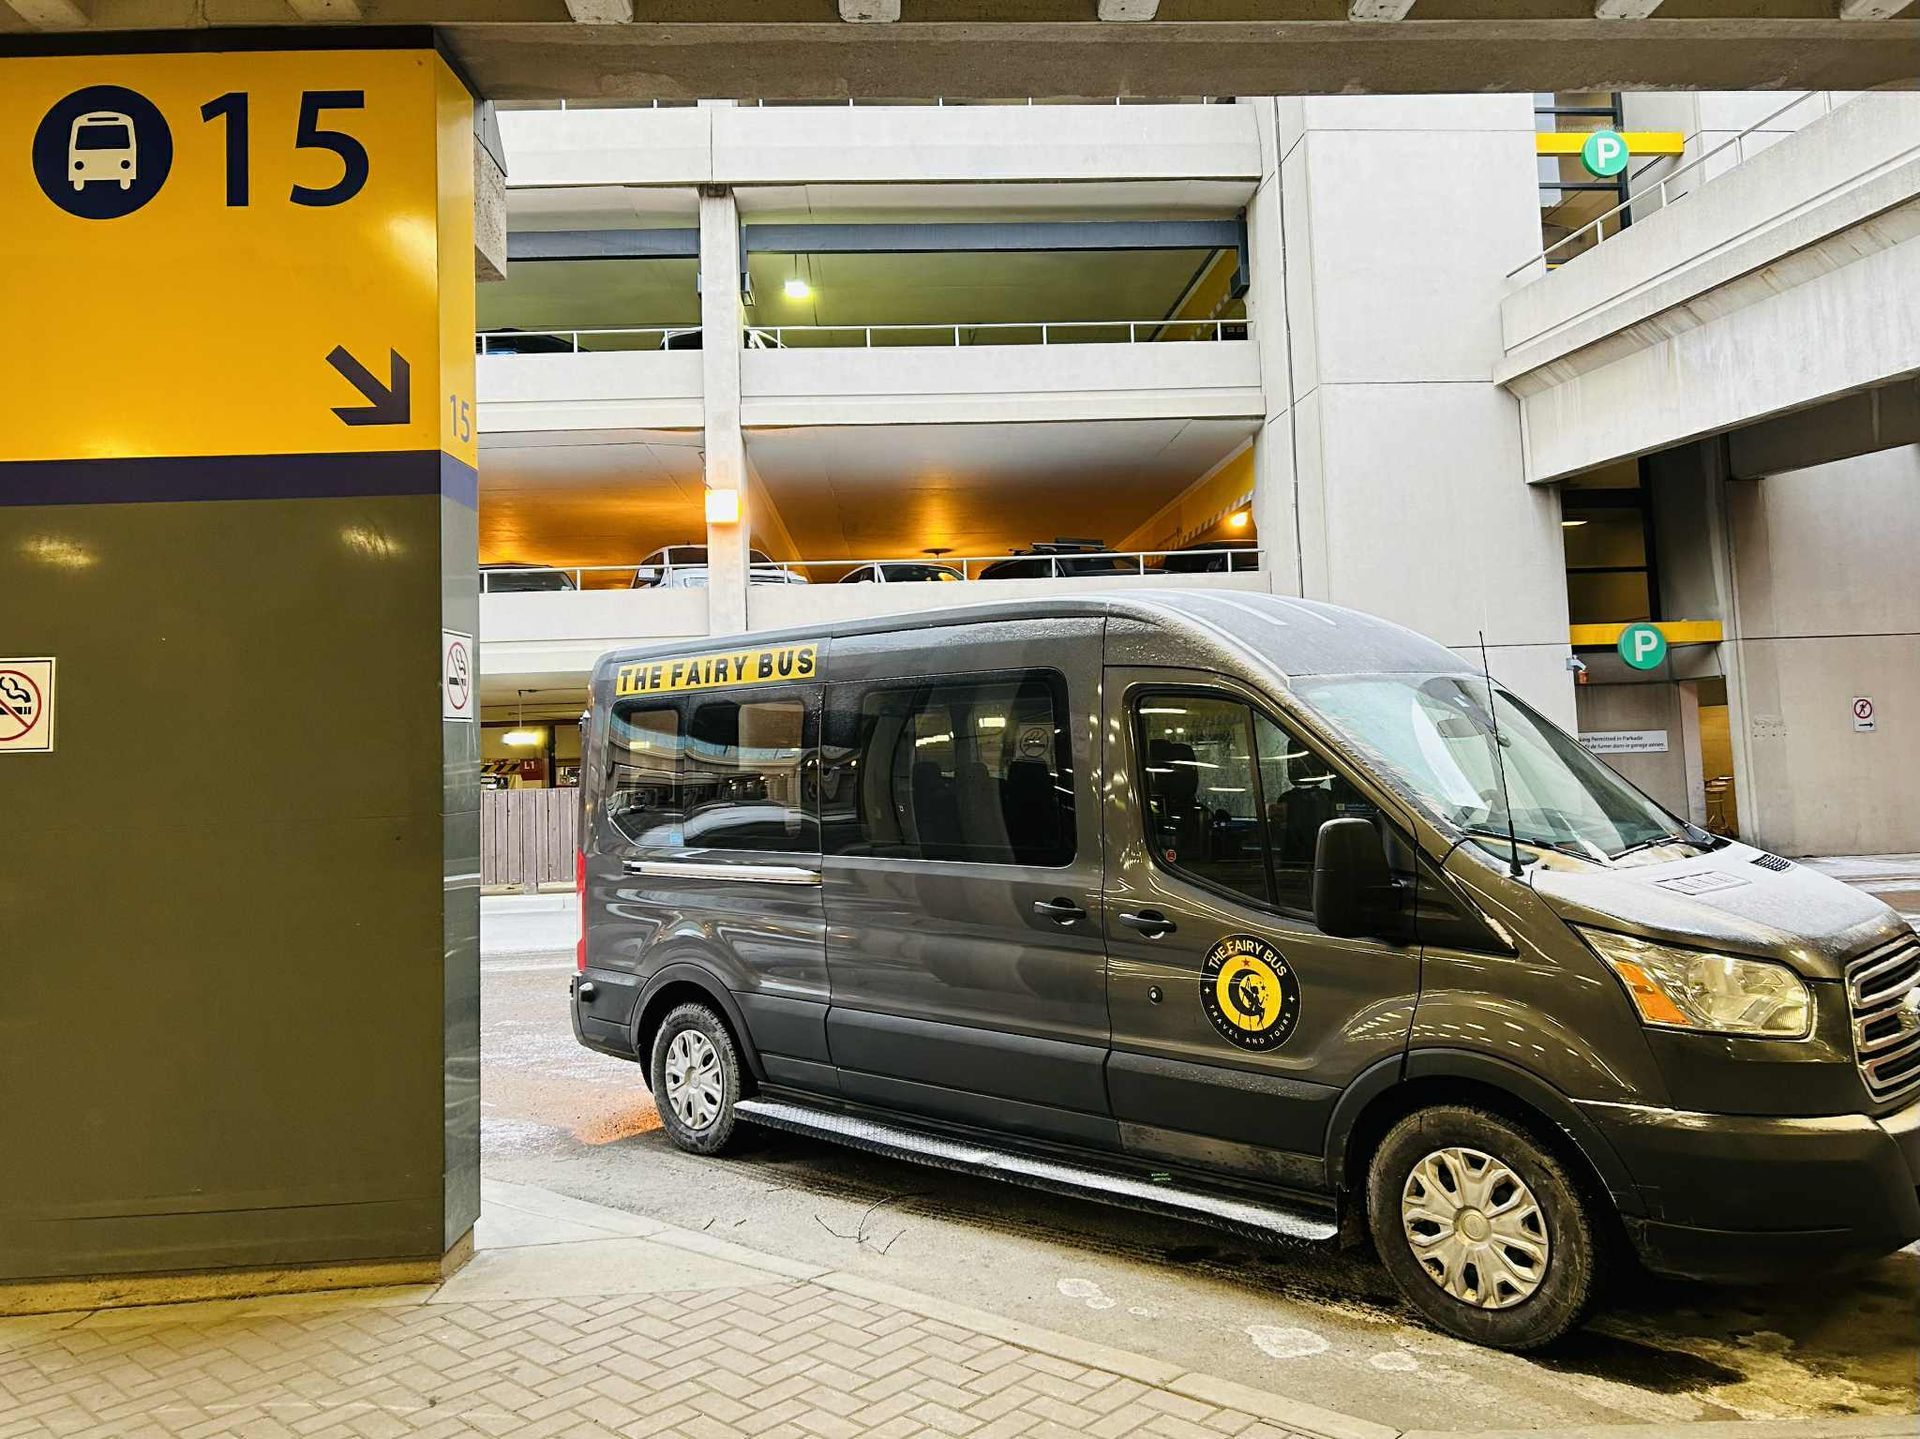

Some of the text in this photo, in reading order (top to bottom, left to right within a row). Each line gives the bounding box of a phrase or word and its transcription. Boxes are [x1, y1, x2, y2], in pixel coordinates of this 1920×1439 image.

[200, 90, 369, 207] 15
[1597, 137, 1620, 168] P
[450, 395, 470, 443] 15
[1634, 630, 1658, 662] P
[620, 666, 662, 692] THE
[758, 648, 813, 678] BUS
[524, 760, 535, 770] L1
[1208, 939, 1287, 977] THE FAIRY BUS
[1209, 1004, 1291, 1045] TRAVEL AND TOURS
